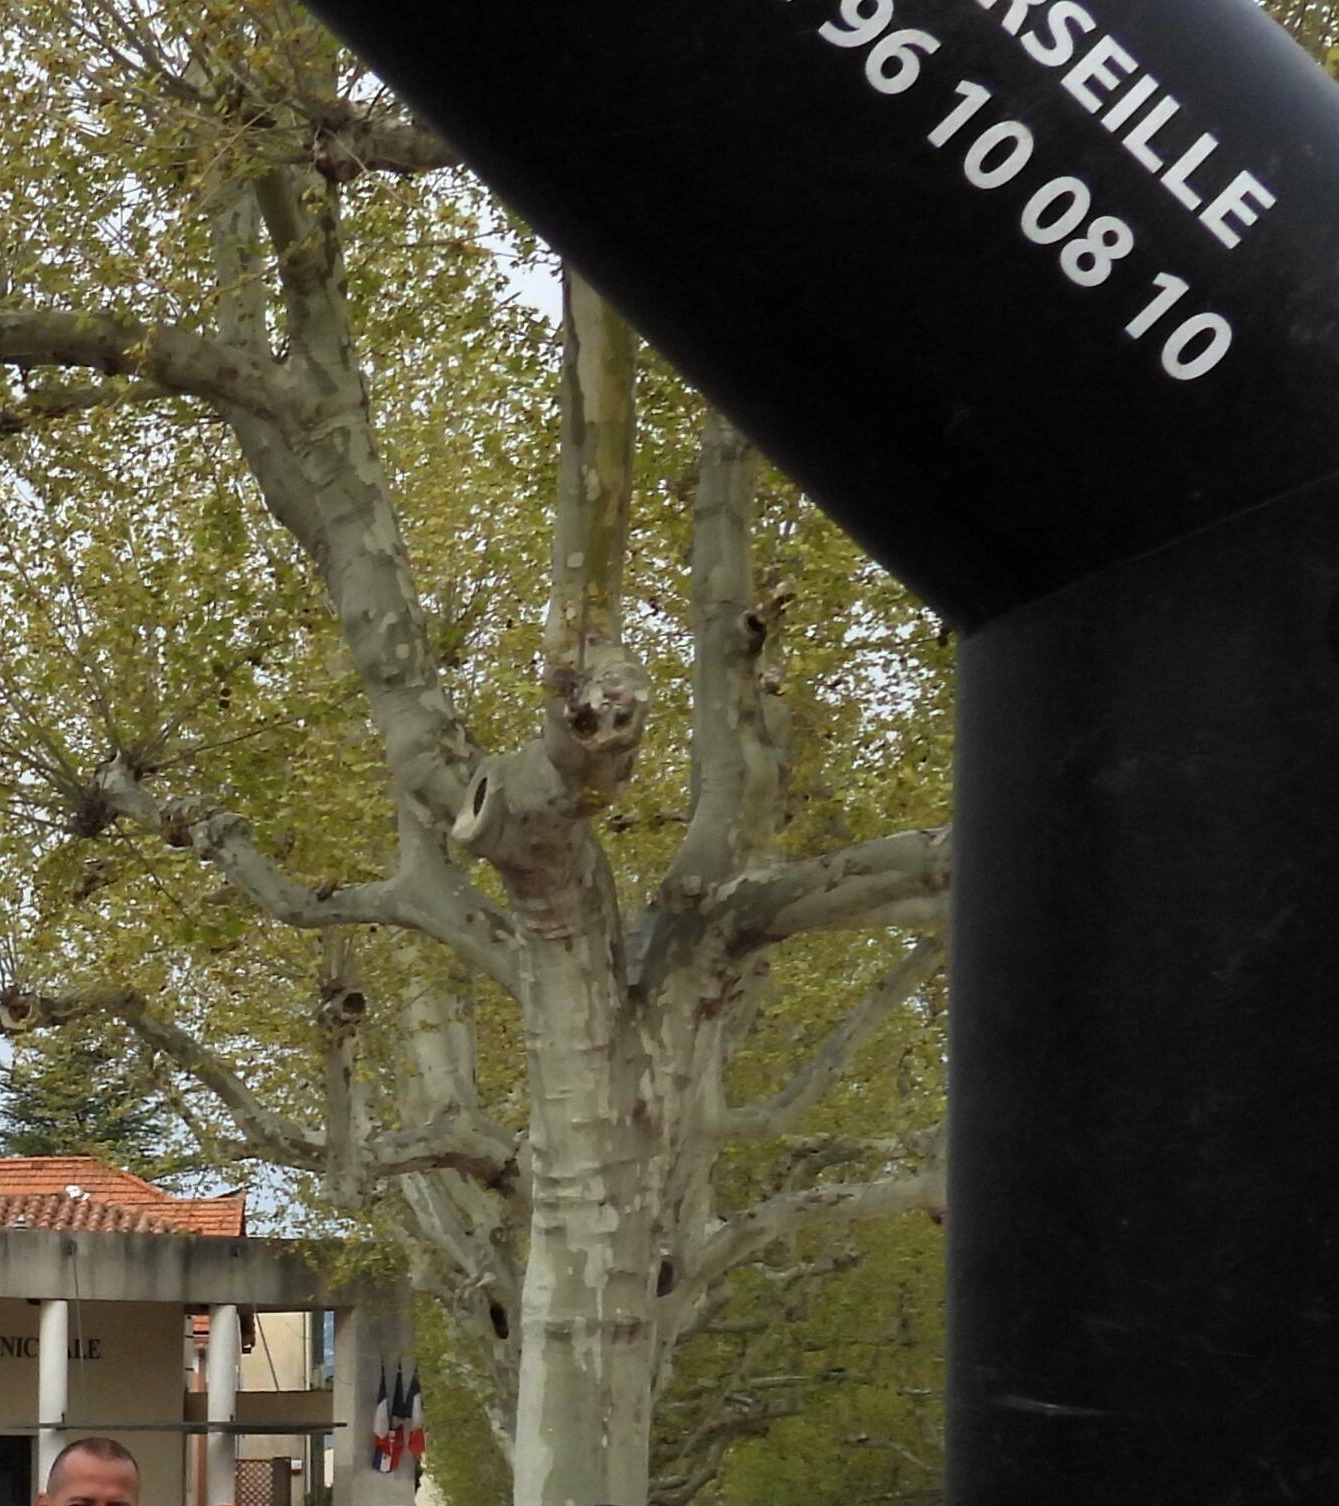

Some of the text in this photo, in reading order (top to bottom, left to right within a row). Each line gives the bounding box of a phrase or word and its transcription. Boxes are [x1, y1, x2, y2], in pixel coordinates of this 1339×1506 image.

[818, 0, 1233, 381] 96 10 08 10
